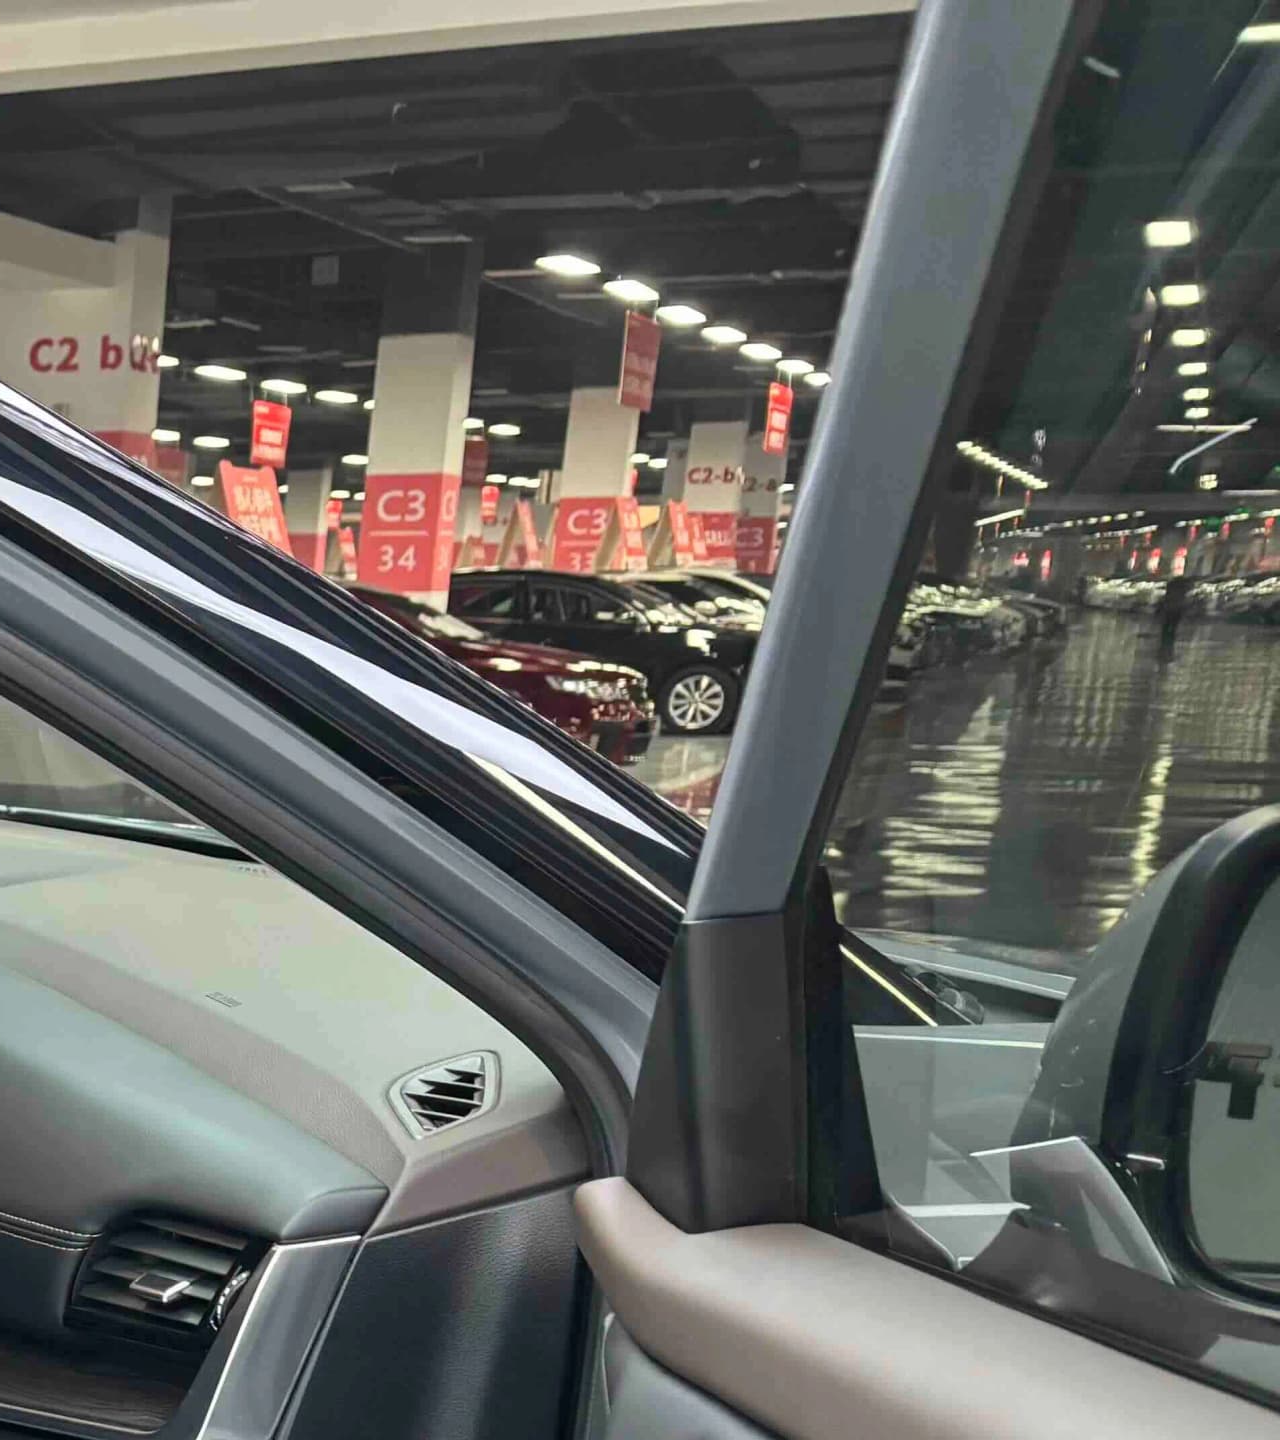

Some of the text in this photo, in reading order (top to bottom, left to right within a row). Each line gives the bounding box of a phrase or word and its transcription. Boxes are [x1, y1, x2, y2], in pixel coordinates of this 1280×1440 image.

[29, 336, 79, 373] C2
[377, 489, 426, 523] C3
[567, 508, 607, 535] C3
[377, 545, 416, 572] 34
